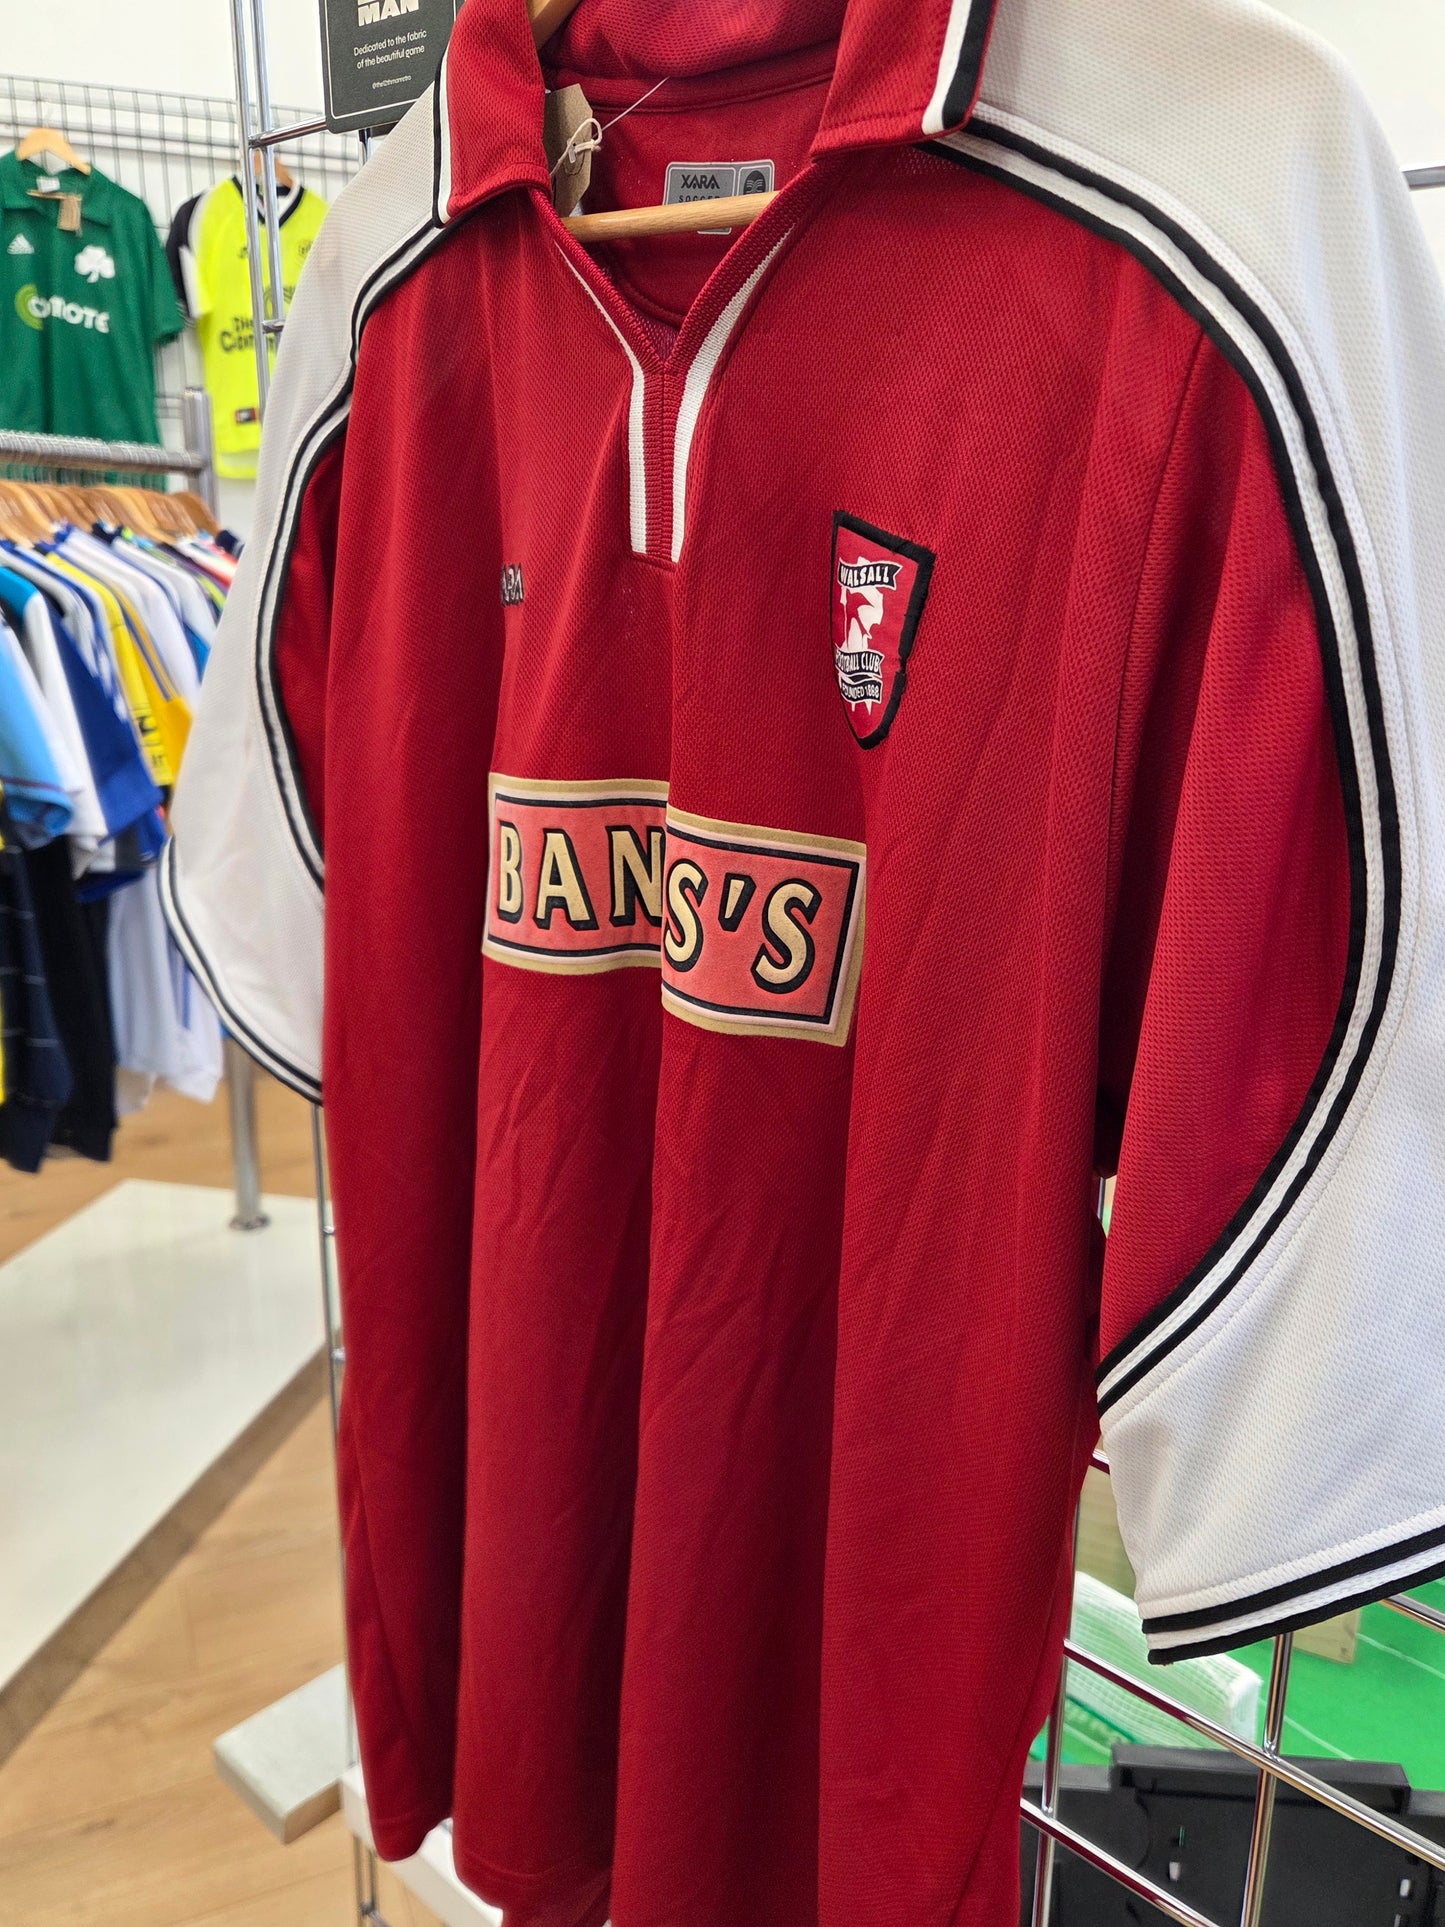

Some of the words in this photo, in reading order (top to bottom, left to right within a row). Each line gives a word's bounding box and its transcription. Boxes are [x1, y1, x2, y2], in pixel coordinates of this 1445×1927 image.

[357, 0, 420, 27] MAN
[354, 39, 387, 56] Dedicated
[387, 38, 395, 47] to
[395, 35, 407, 45] the
[407, 29, 427, 42] fabric
[356, 59, 364, 69] of
[365, 57, 376, 67] the
[376, 49, 405, 64] beautiful
[405, 45, 425, 58] game
[680, 174, 720, 190] XARA
[841, 565, 889, 587] WALSALL
[861, 652, 880, 673] CLUB
